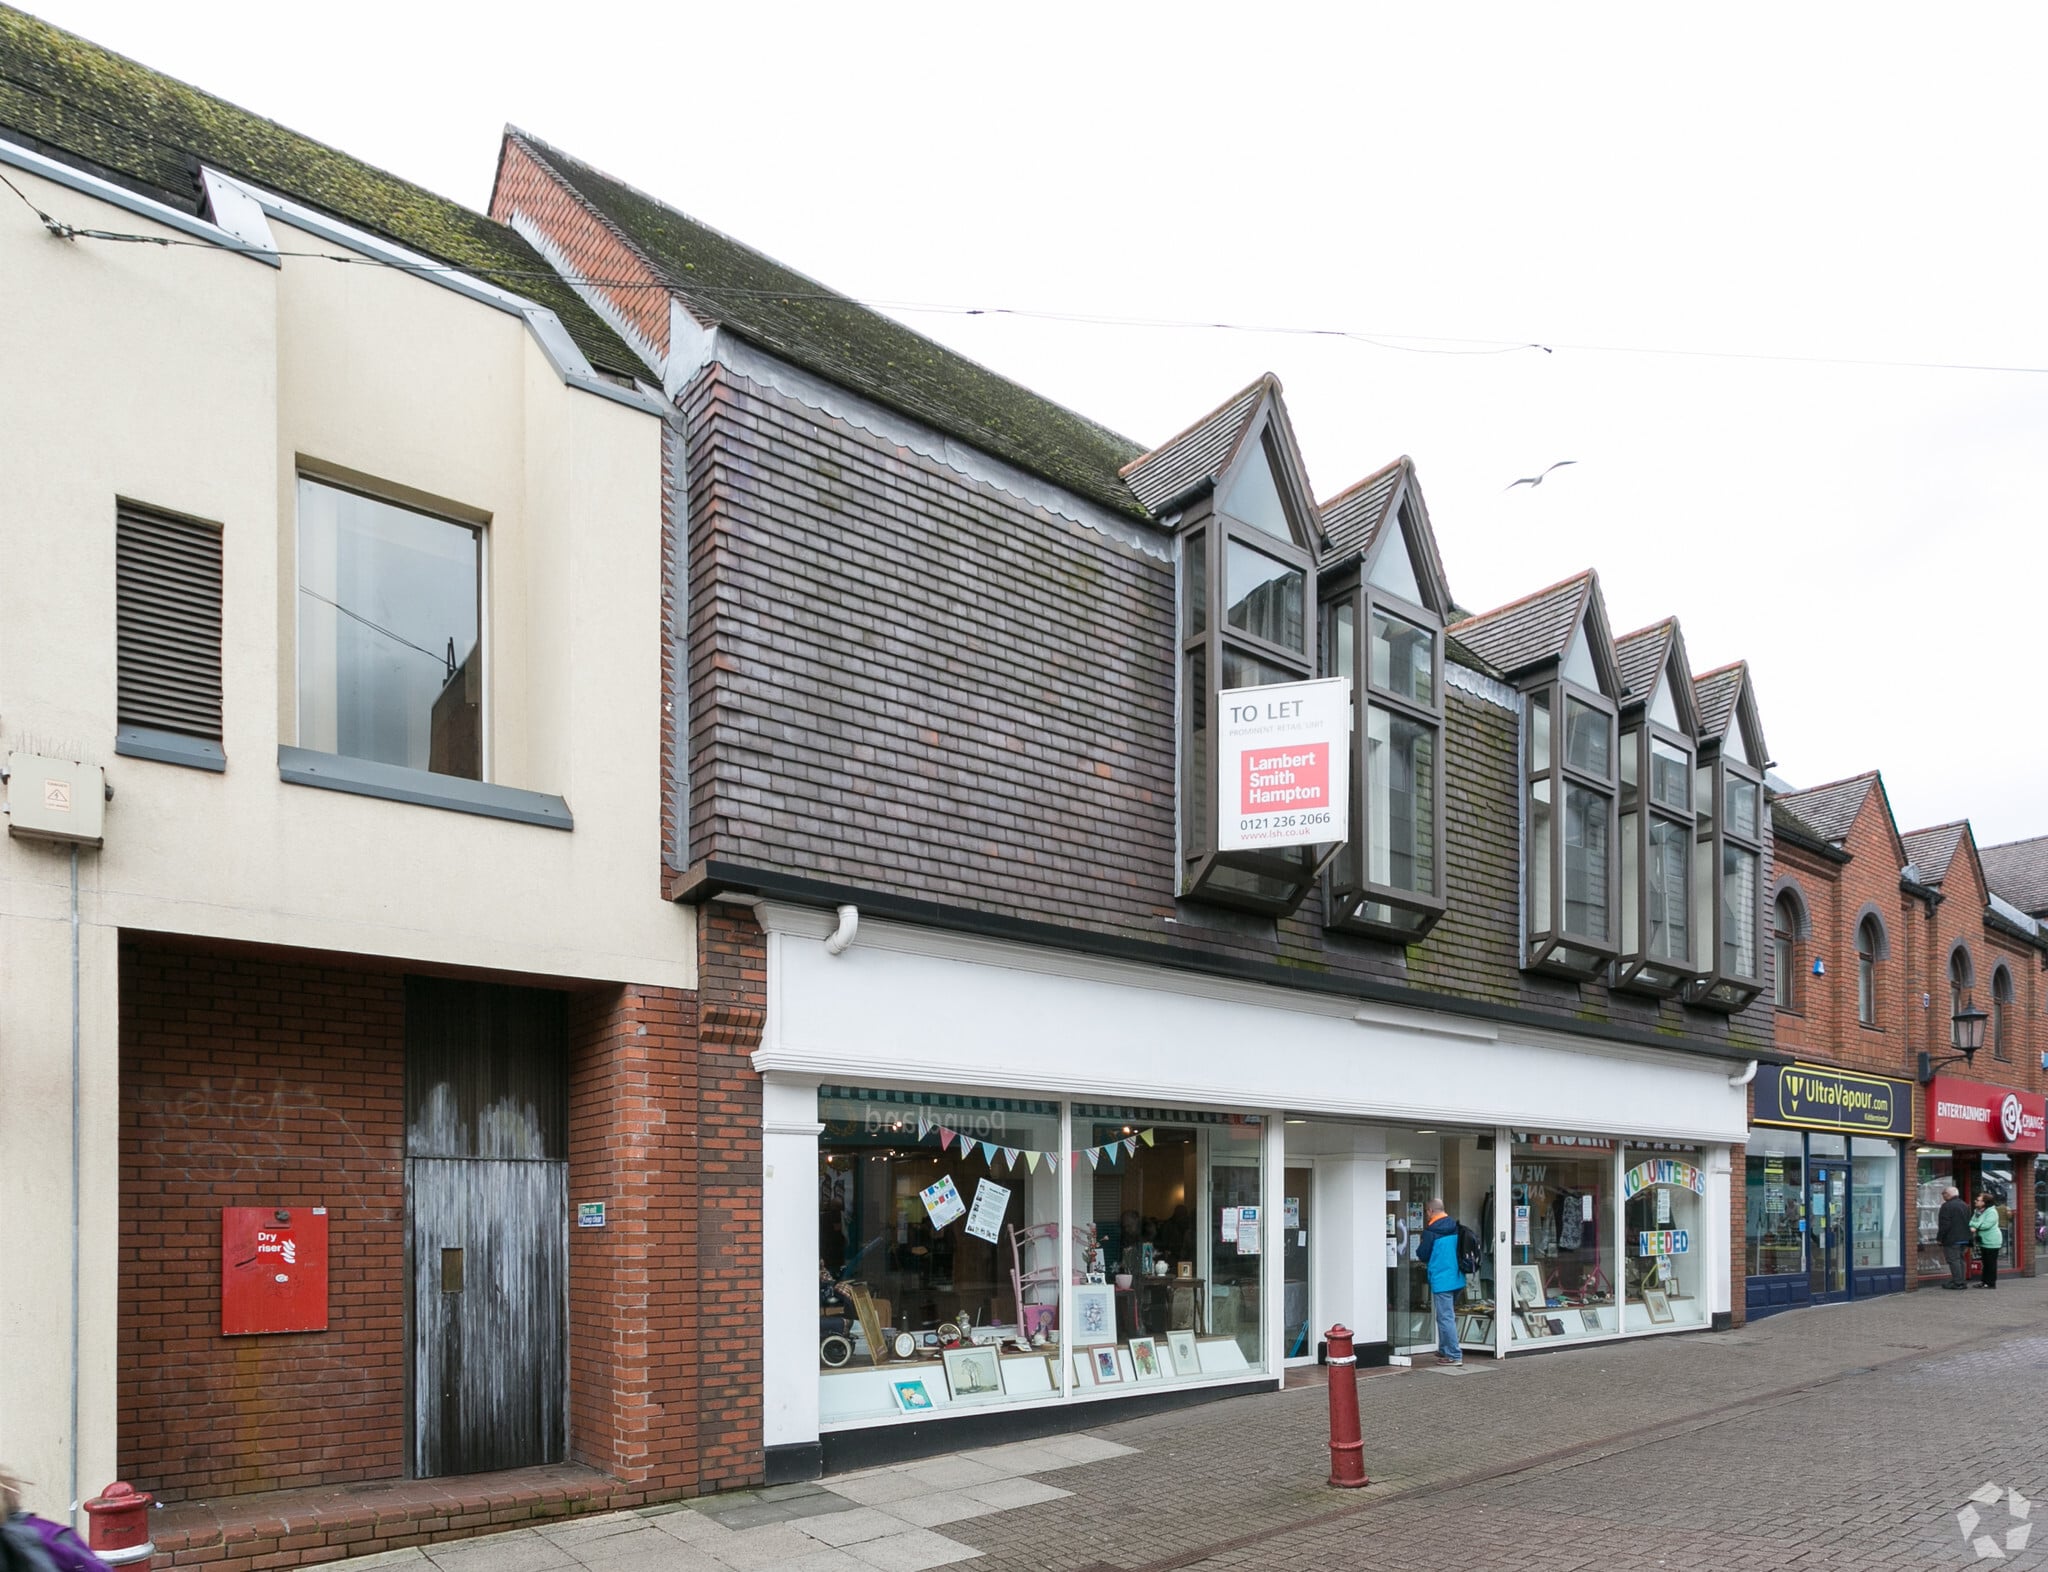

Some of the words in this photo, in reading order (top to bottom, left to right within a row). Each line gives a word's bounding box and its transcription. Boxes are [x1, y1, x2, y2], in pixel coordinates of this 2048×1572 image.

[1230, 705, 1258, 723] TO
[1268, 700, 1304, 720] LET
[1229, 725, 1274, 736] PROMINENT
[1250, 752, 1316, 771] Lambert
[1250, 770, 1295, 788] Smith
[1250, 785, 1321, 804] Hampton
[1240, 818, 1268, 831] 0121
[1274, 815, 1296, 827] 236
[1300, 812, 1331, 826] 2066
[1240, 827, 1311, 840] www.lsh.co.uk
[1806, 1078, 1888, 1112] UltraVapour.com
[1938, 1101, 1991, 1122] ENTERTAINMENT
[1624, 1160, 1705, 1198] VOLUNTEERS
[258, 1232, 277, 1243] Dry
[1640, 1230, 1689, 1256] NEEDED
[258, 1244, 282, 1252] riser
